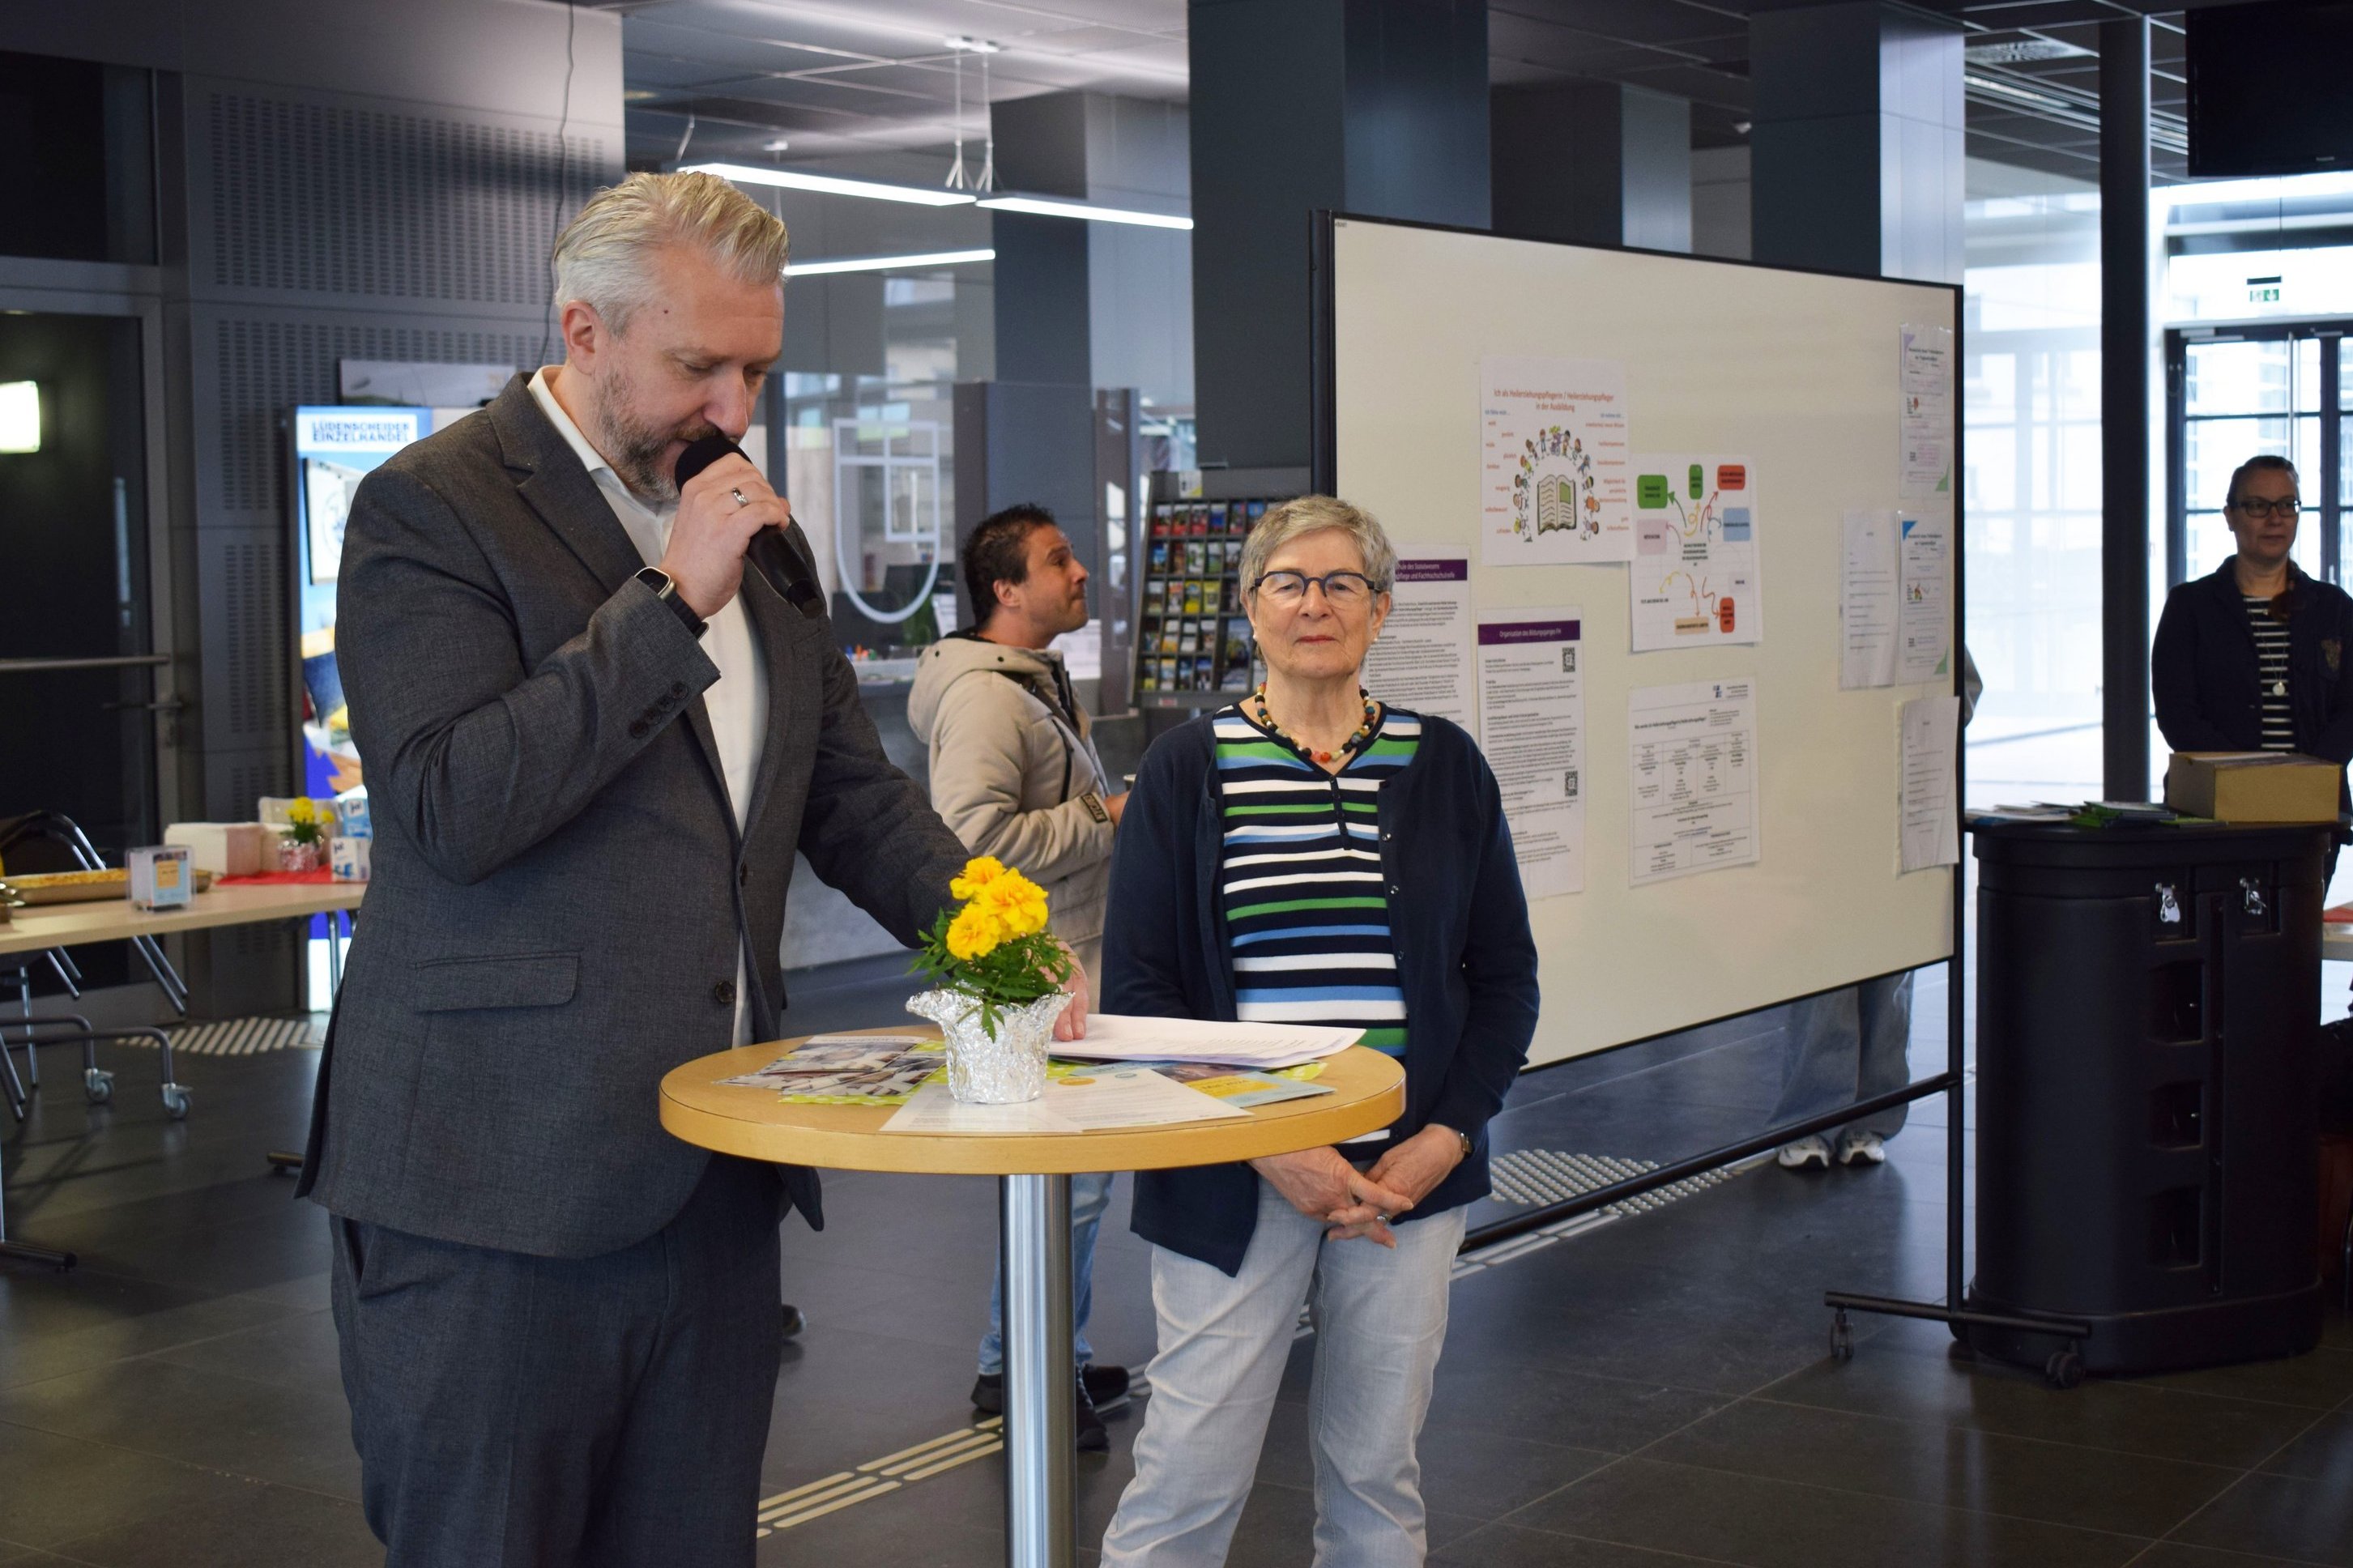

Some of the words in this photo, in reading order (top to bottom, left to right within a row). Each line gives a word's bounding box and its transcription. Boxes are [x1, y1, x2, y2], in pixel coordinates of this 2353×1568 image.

[1550, 403, 1575, 413] Ausbildung
[312, 420, 410, 430] LÜDENSCHEIDER
[313, 431, 409, 442] EINZELHANDEL
